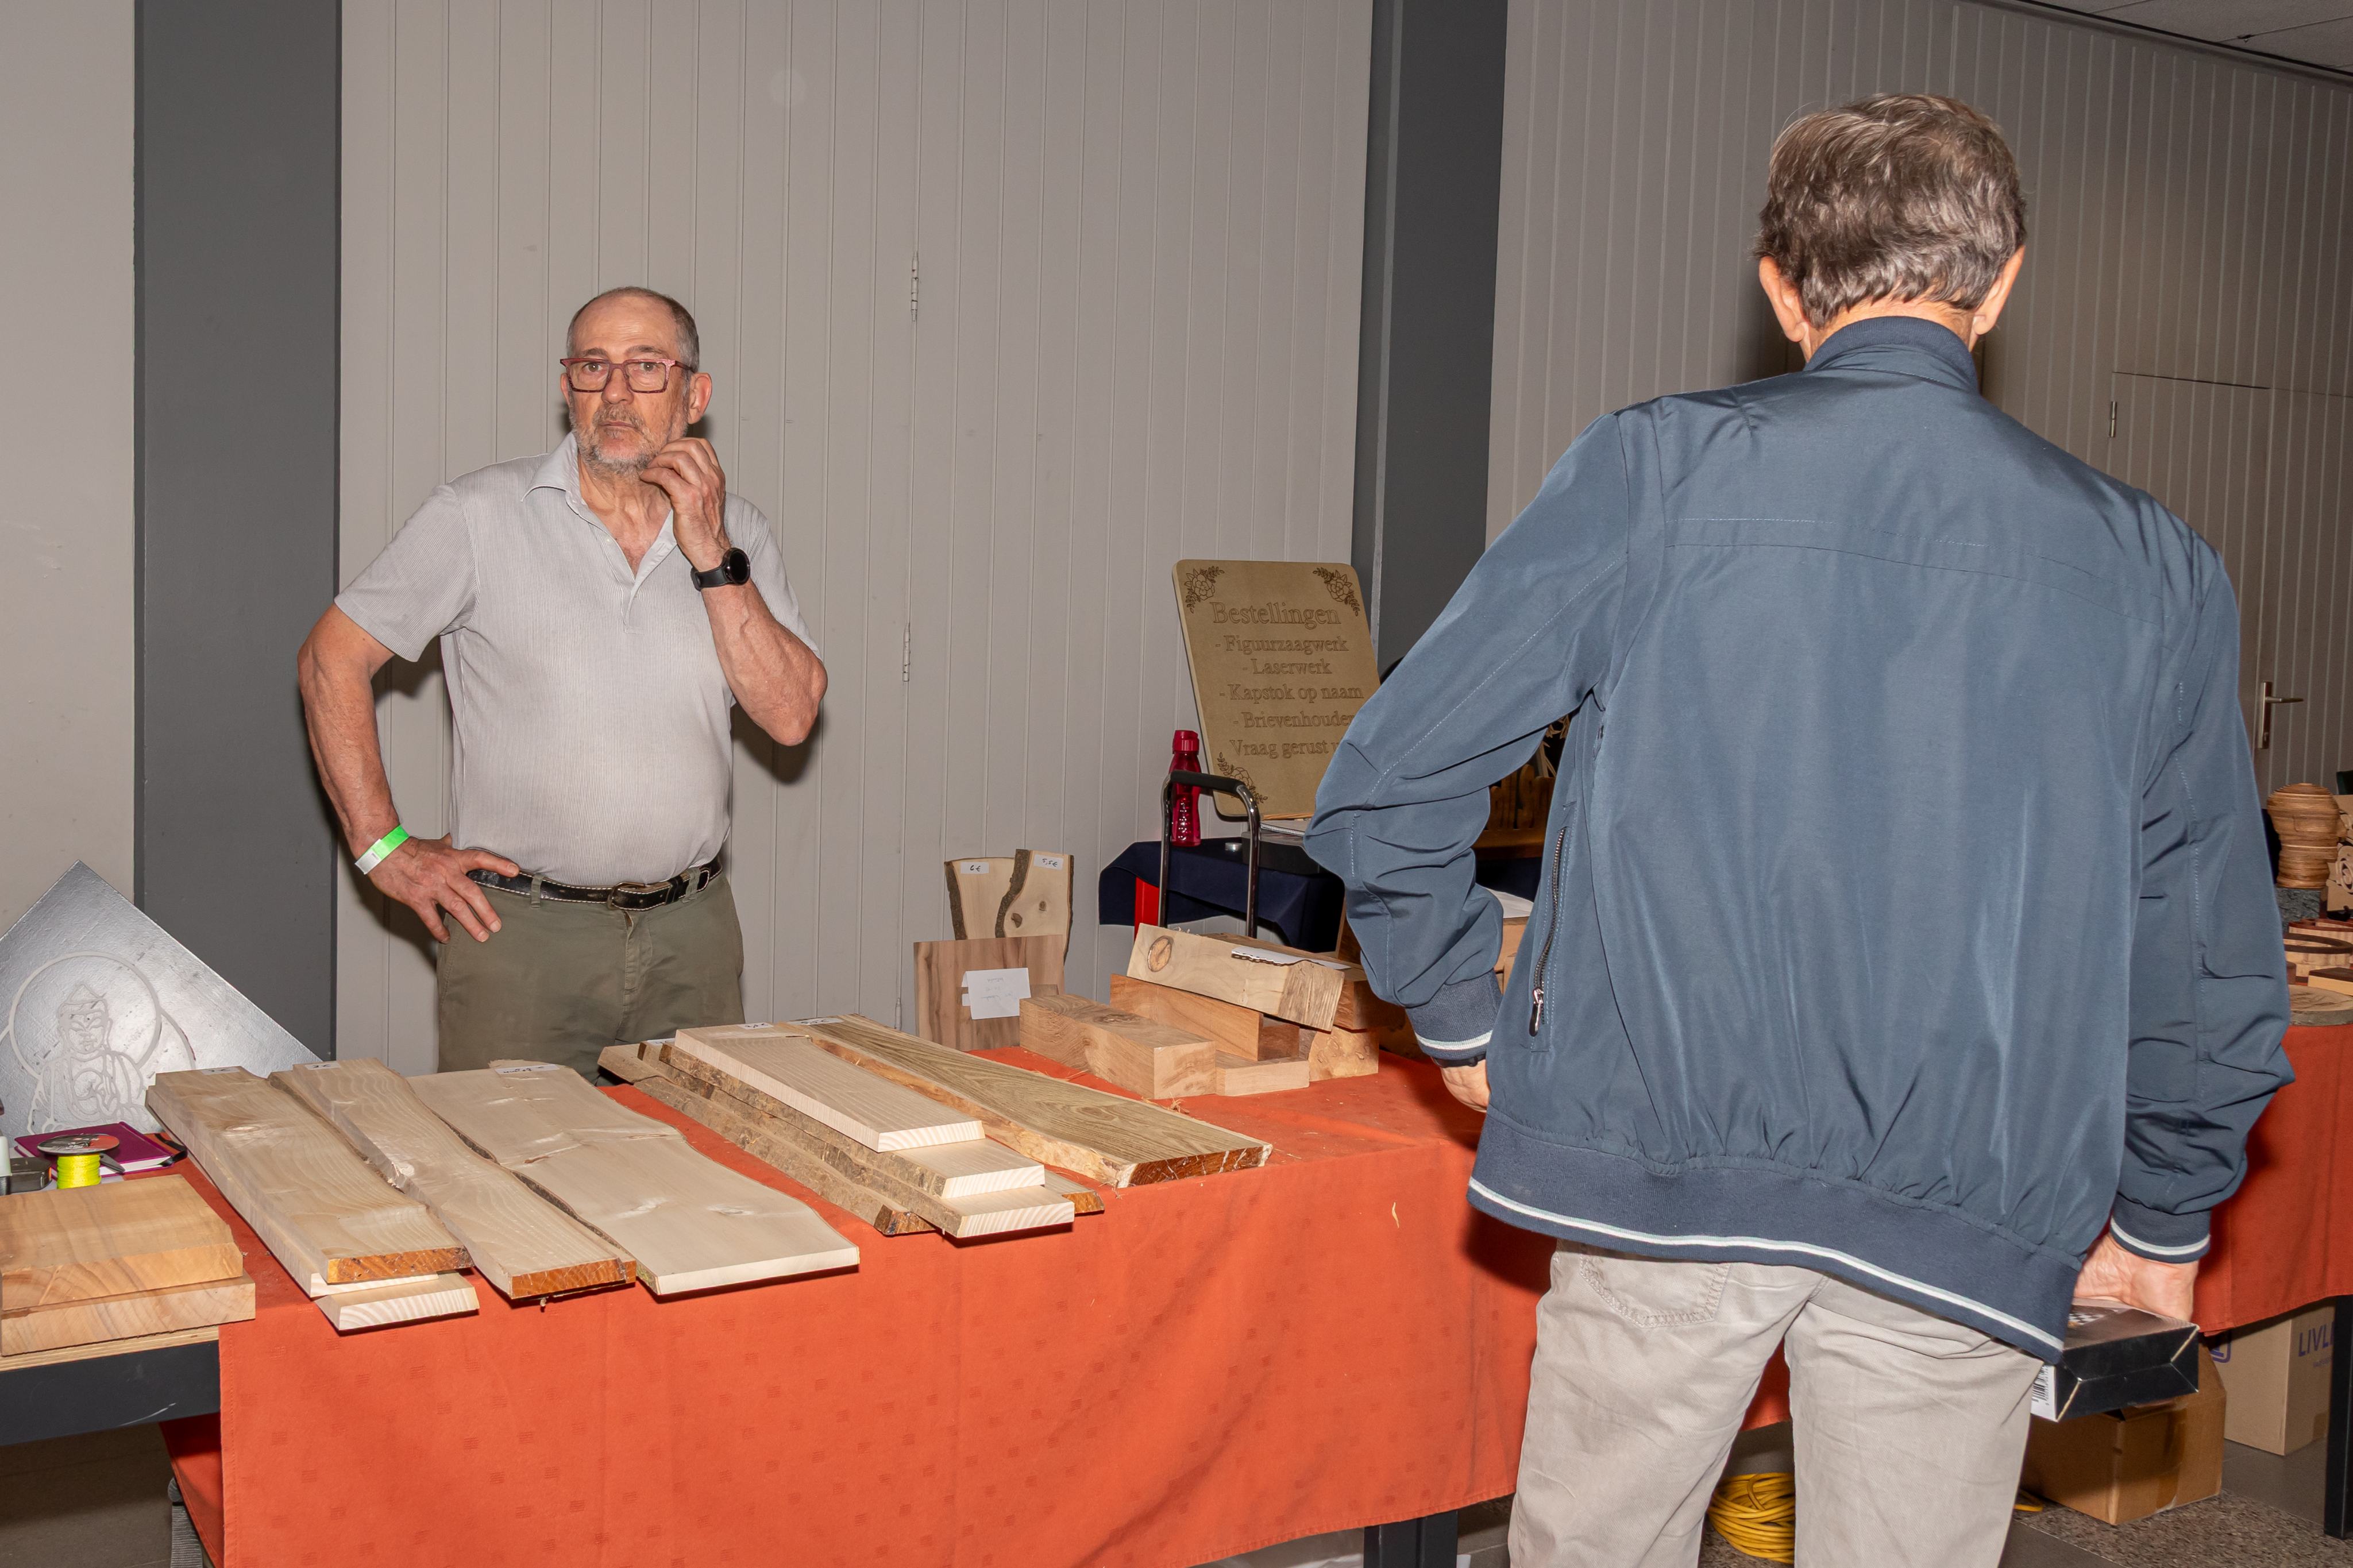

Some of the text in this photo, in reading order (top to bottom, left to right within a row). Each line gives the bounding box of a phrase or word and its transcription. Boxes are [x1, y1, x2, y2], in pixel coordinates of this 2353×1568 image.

[1209, 602, 1341, 630] Bestellingen
[1224, 635, 1349, 655] Figuurzaagwerk
[1250, 658, 1333, 675] Laserwerk
[1227, 683, 1295, 704] Kapstok
[1298, 687, 1317, 704] op
[1321, 687, 1365, 699] naam
[1229, 739, 1279, 759] Vraag
[1282, 740, 1329, 759] gerust
